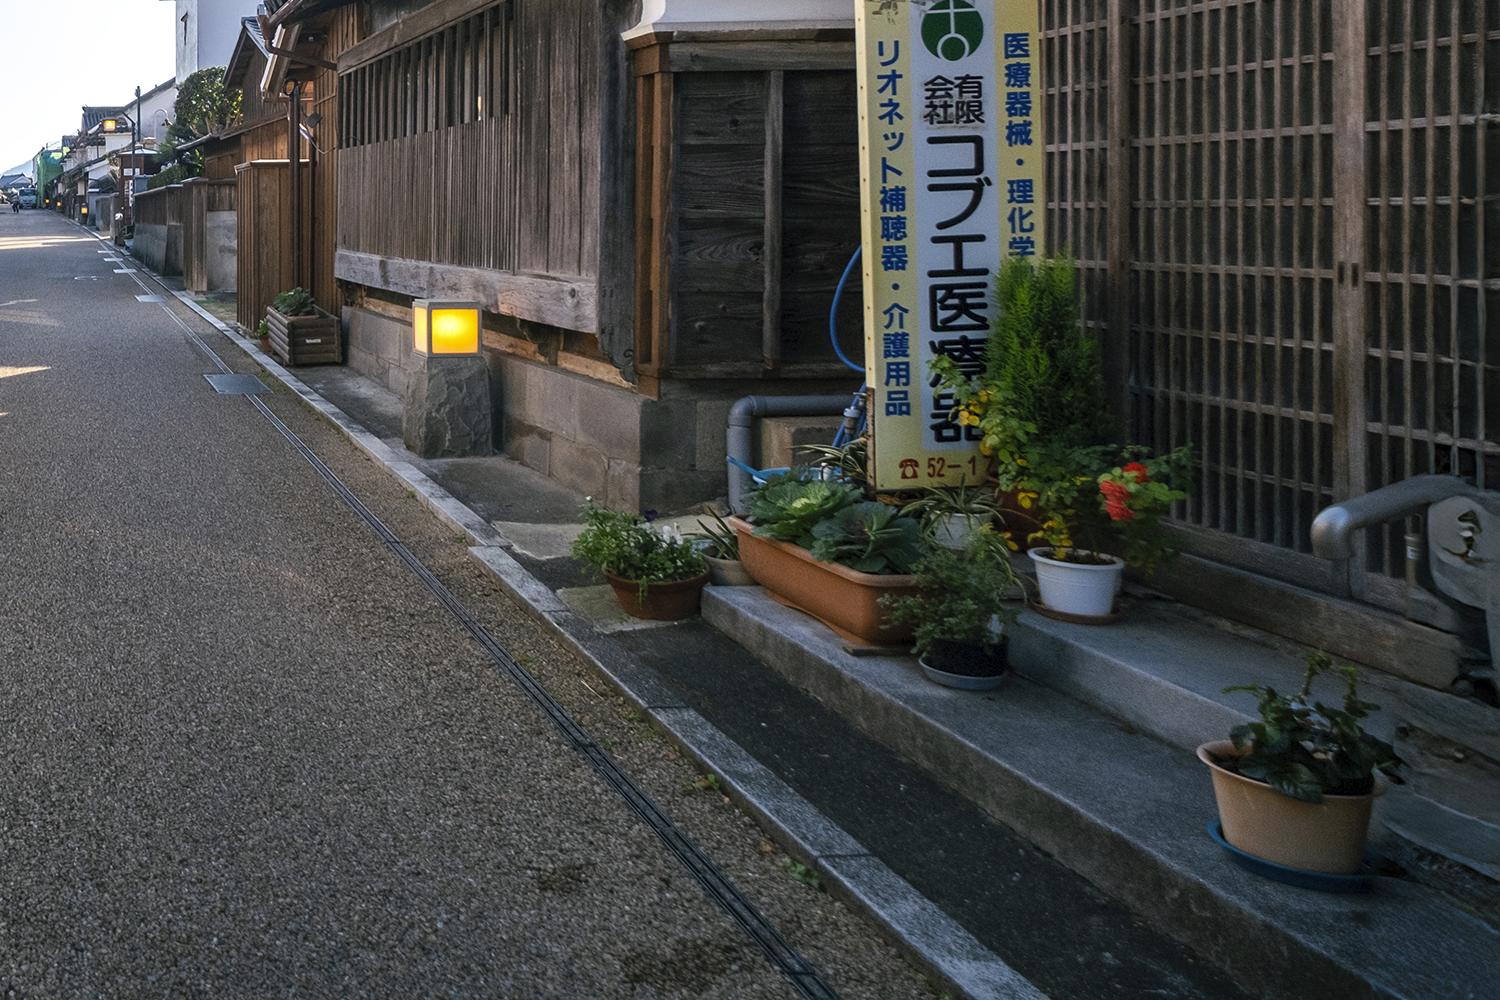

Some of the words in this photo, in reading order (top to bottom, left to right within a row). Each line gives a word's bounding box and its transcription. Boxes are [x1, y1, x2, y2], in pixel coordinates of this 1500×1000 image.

[876, 40, 911, 416] リオネット補聴器・介護用品
